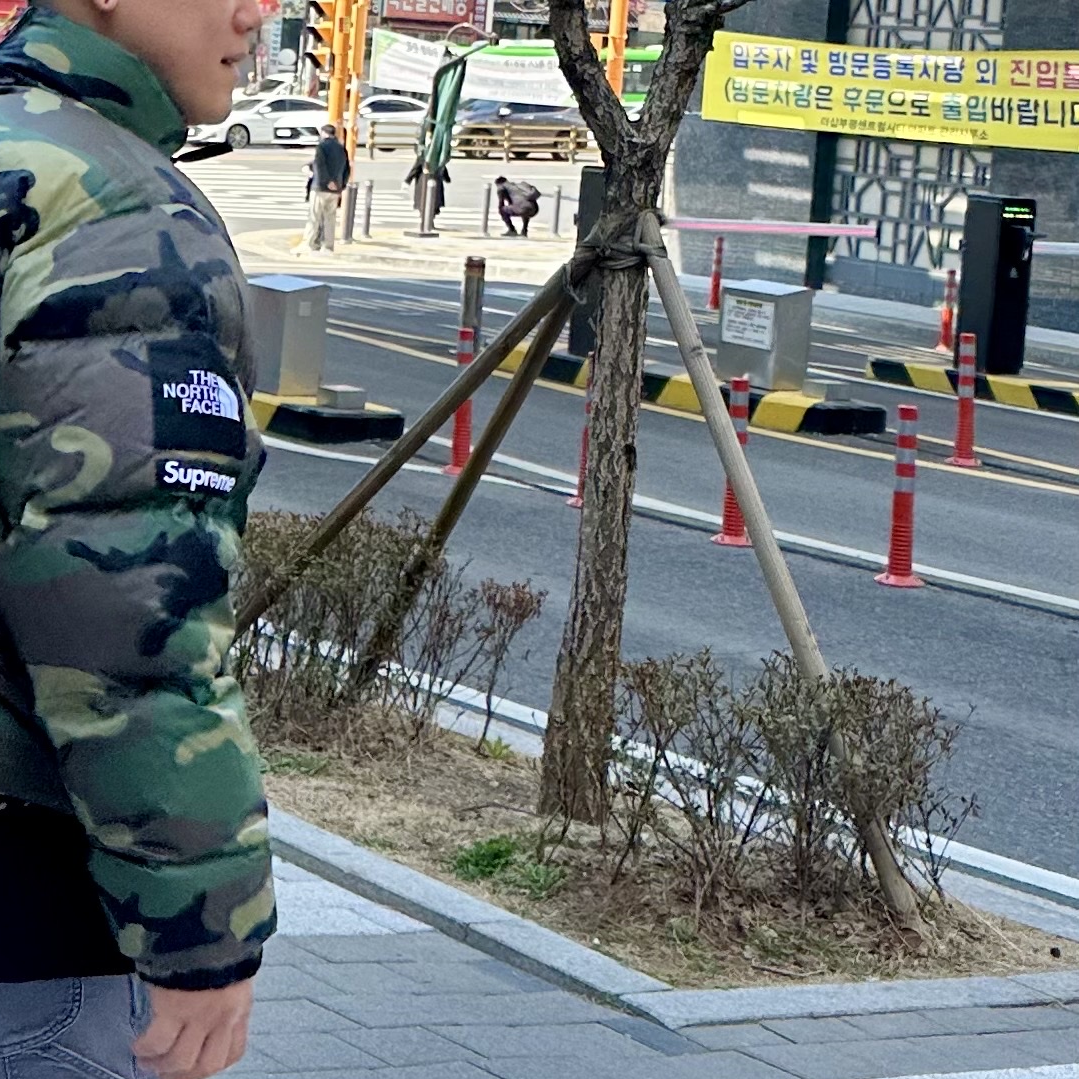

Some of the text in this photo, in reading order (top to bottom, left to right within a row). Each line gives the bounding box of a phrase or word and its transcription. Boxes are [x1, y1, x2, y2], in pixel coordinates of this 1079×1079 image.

[733, 44, 792, 72] 입주자
[801, 49, 819, 74] 및
[828, 51, 965, 83] 방문등록차량
[975, 58, 997, 85] 외
[724, 77, 833, 111] (방문차량은
[843, 87, 931, 117] 후문으로
[188, 369, 220, 388] THE
[162, 383, 220, 401] NORTH
[181, 398, 222, 416] FACE
[163, 460, 236, 493] Supreme
